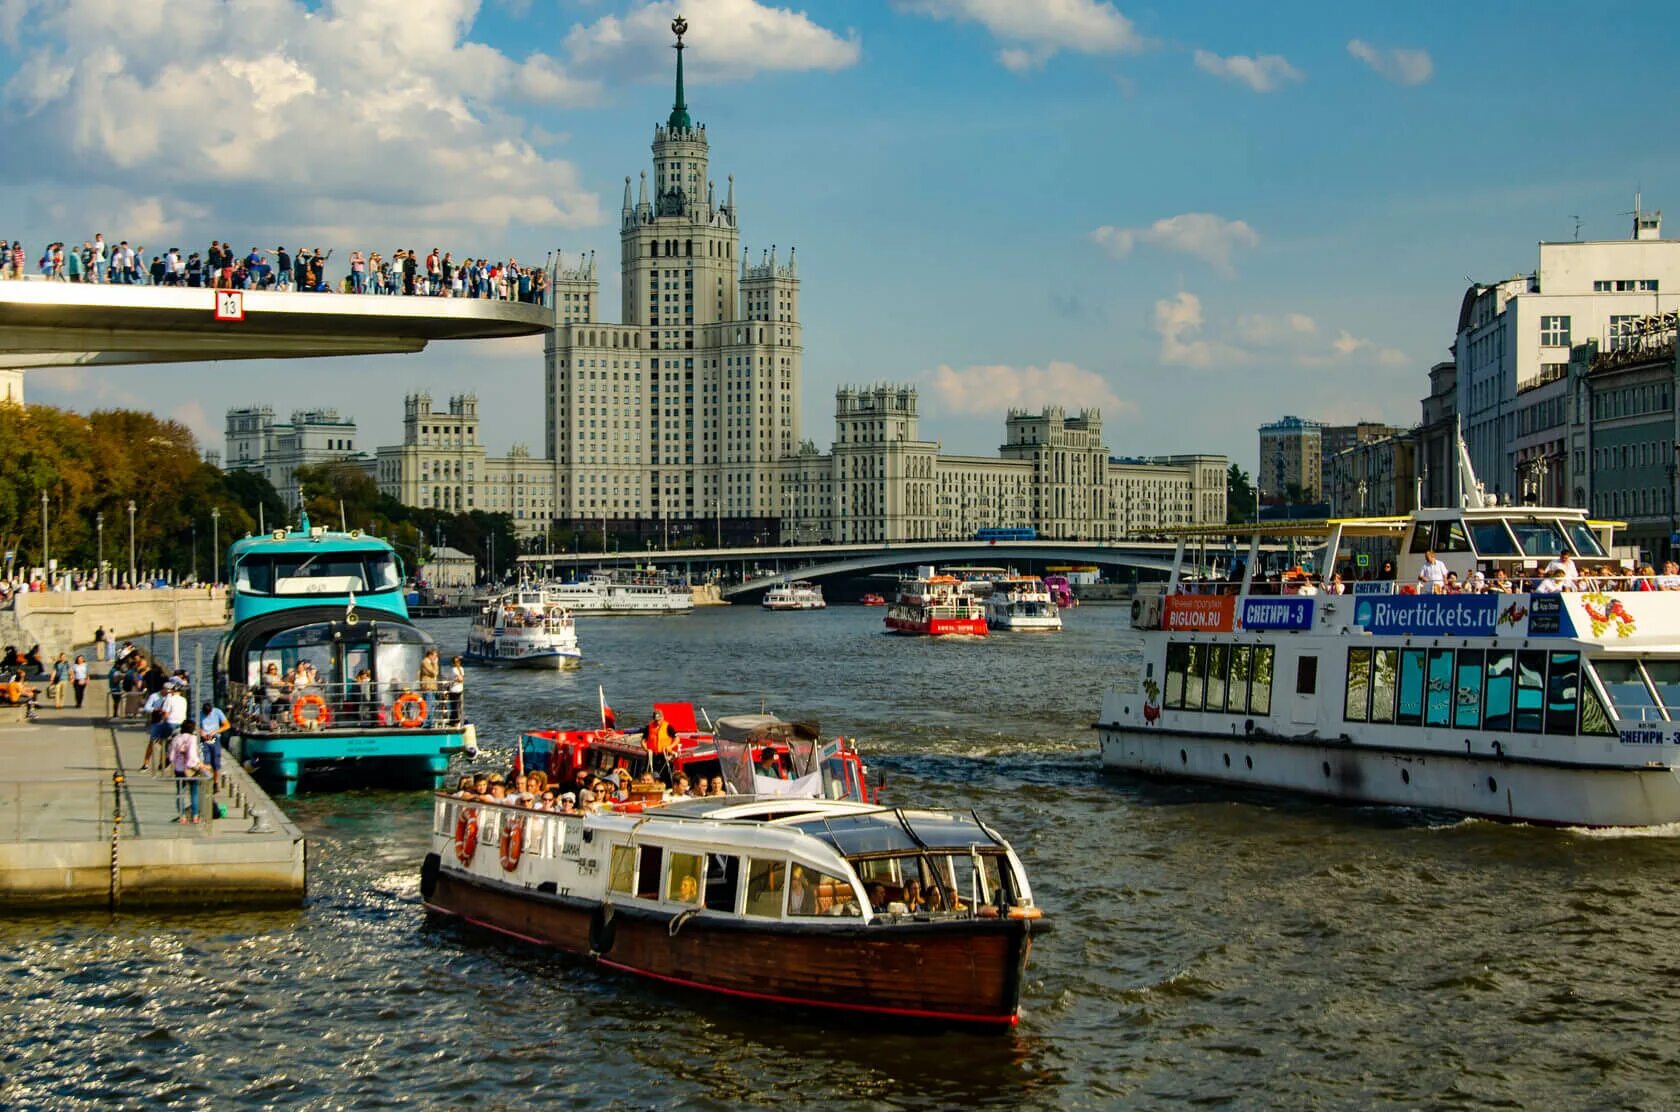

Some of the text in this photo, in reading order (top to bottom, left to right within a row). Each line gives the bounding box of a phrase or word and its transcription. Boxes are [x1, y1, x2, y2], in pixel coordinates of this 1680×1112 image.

[224, 301, 236, 314] 13
[1169, 611, 1220, 626] BIGLION.RU
[1247, 604, 1290, 624] СНЕГИРИ
[1296, 604, 1304, 624] 3
[1375, 602, 1496, 627] Rivertickets.ru
[1620, 730, 1663, 744] СНЕГИРИ
[1673, 732, 1680, 744] 3
